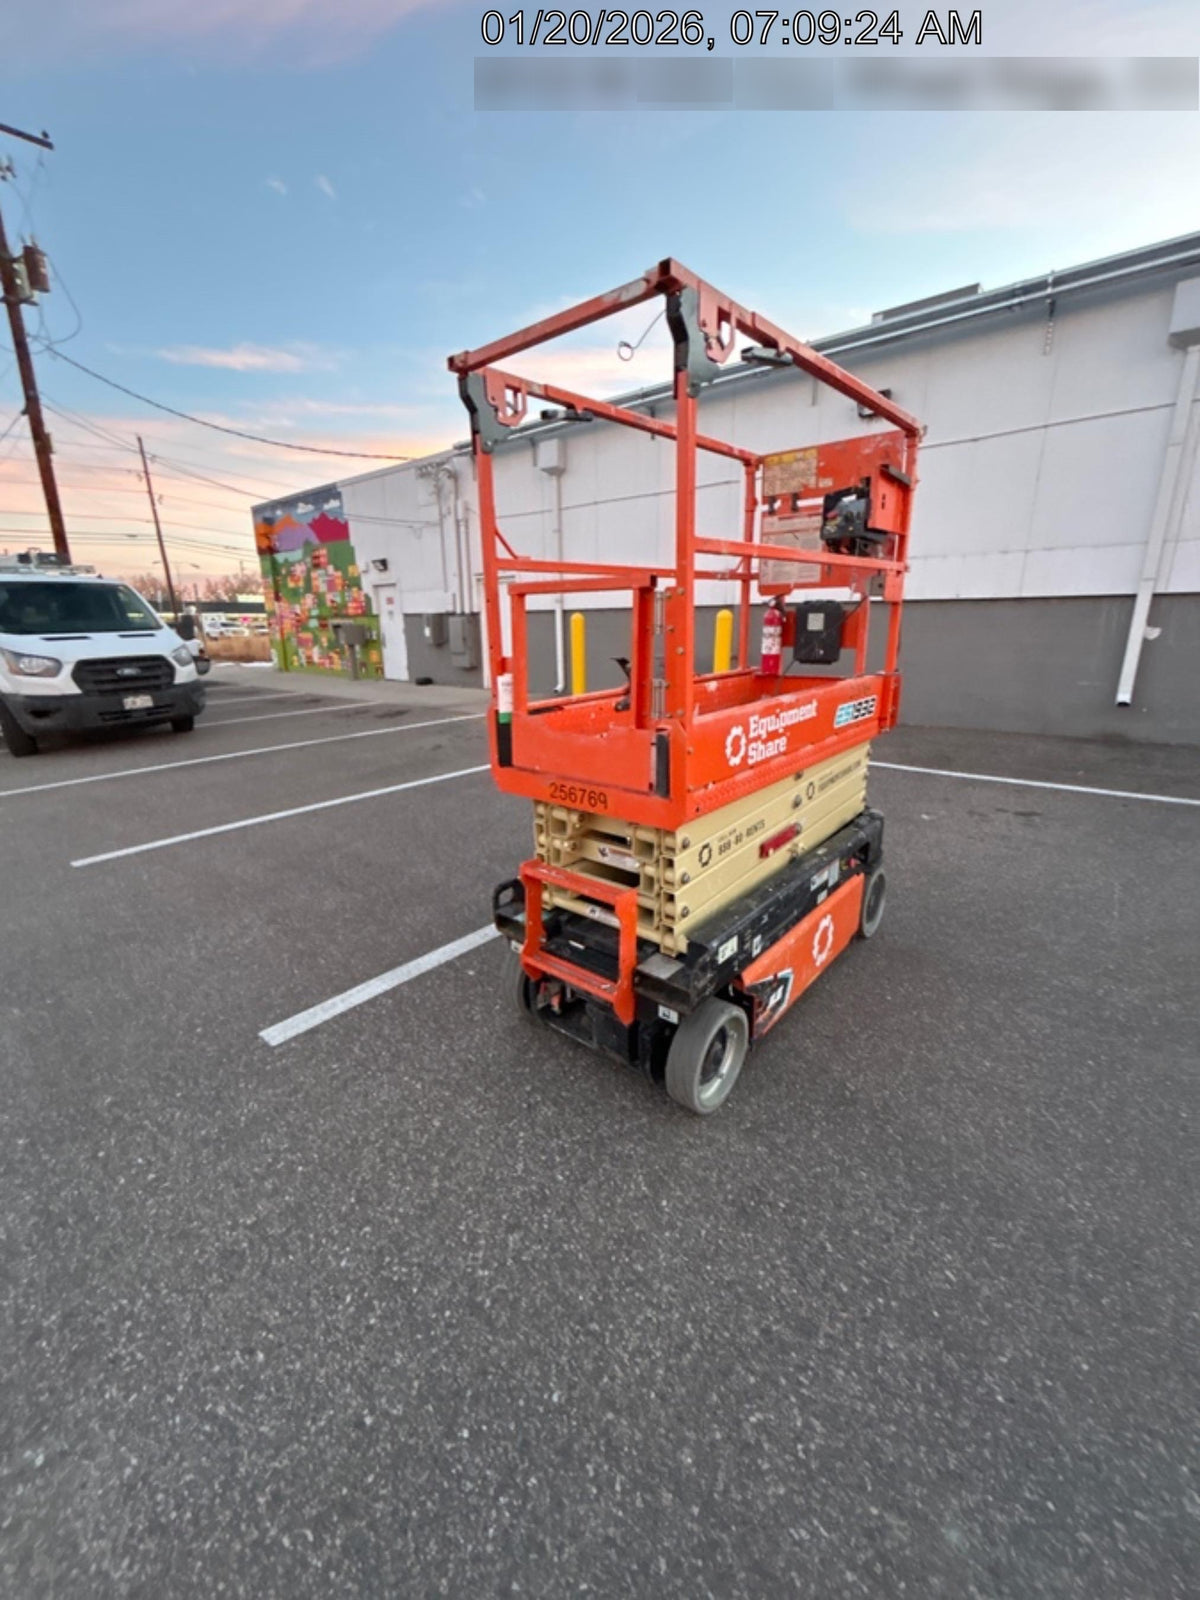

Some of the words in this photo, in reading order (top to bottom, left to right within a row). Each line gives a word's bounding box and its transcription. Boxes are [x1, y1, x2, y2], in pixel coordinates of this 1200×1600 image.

[749, 699, 818, 739] Equipment
[747, 736, 786, 765] Share
[549, 782, 608, 810] 256769
